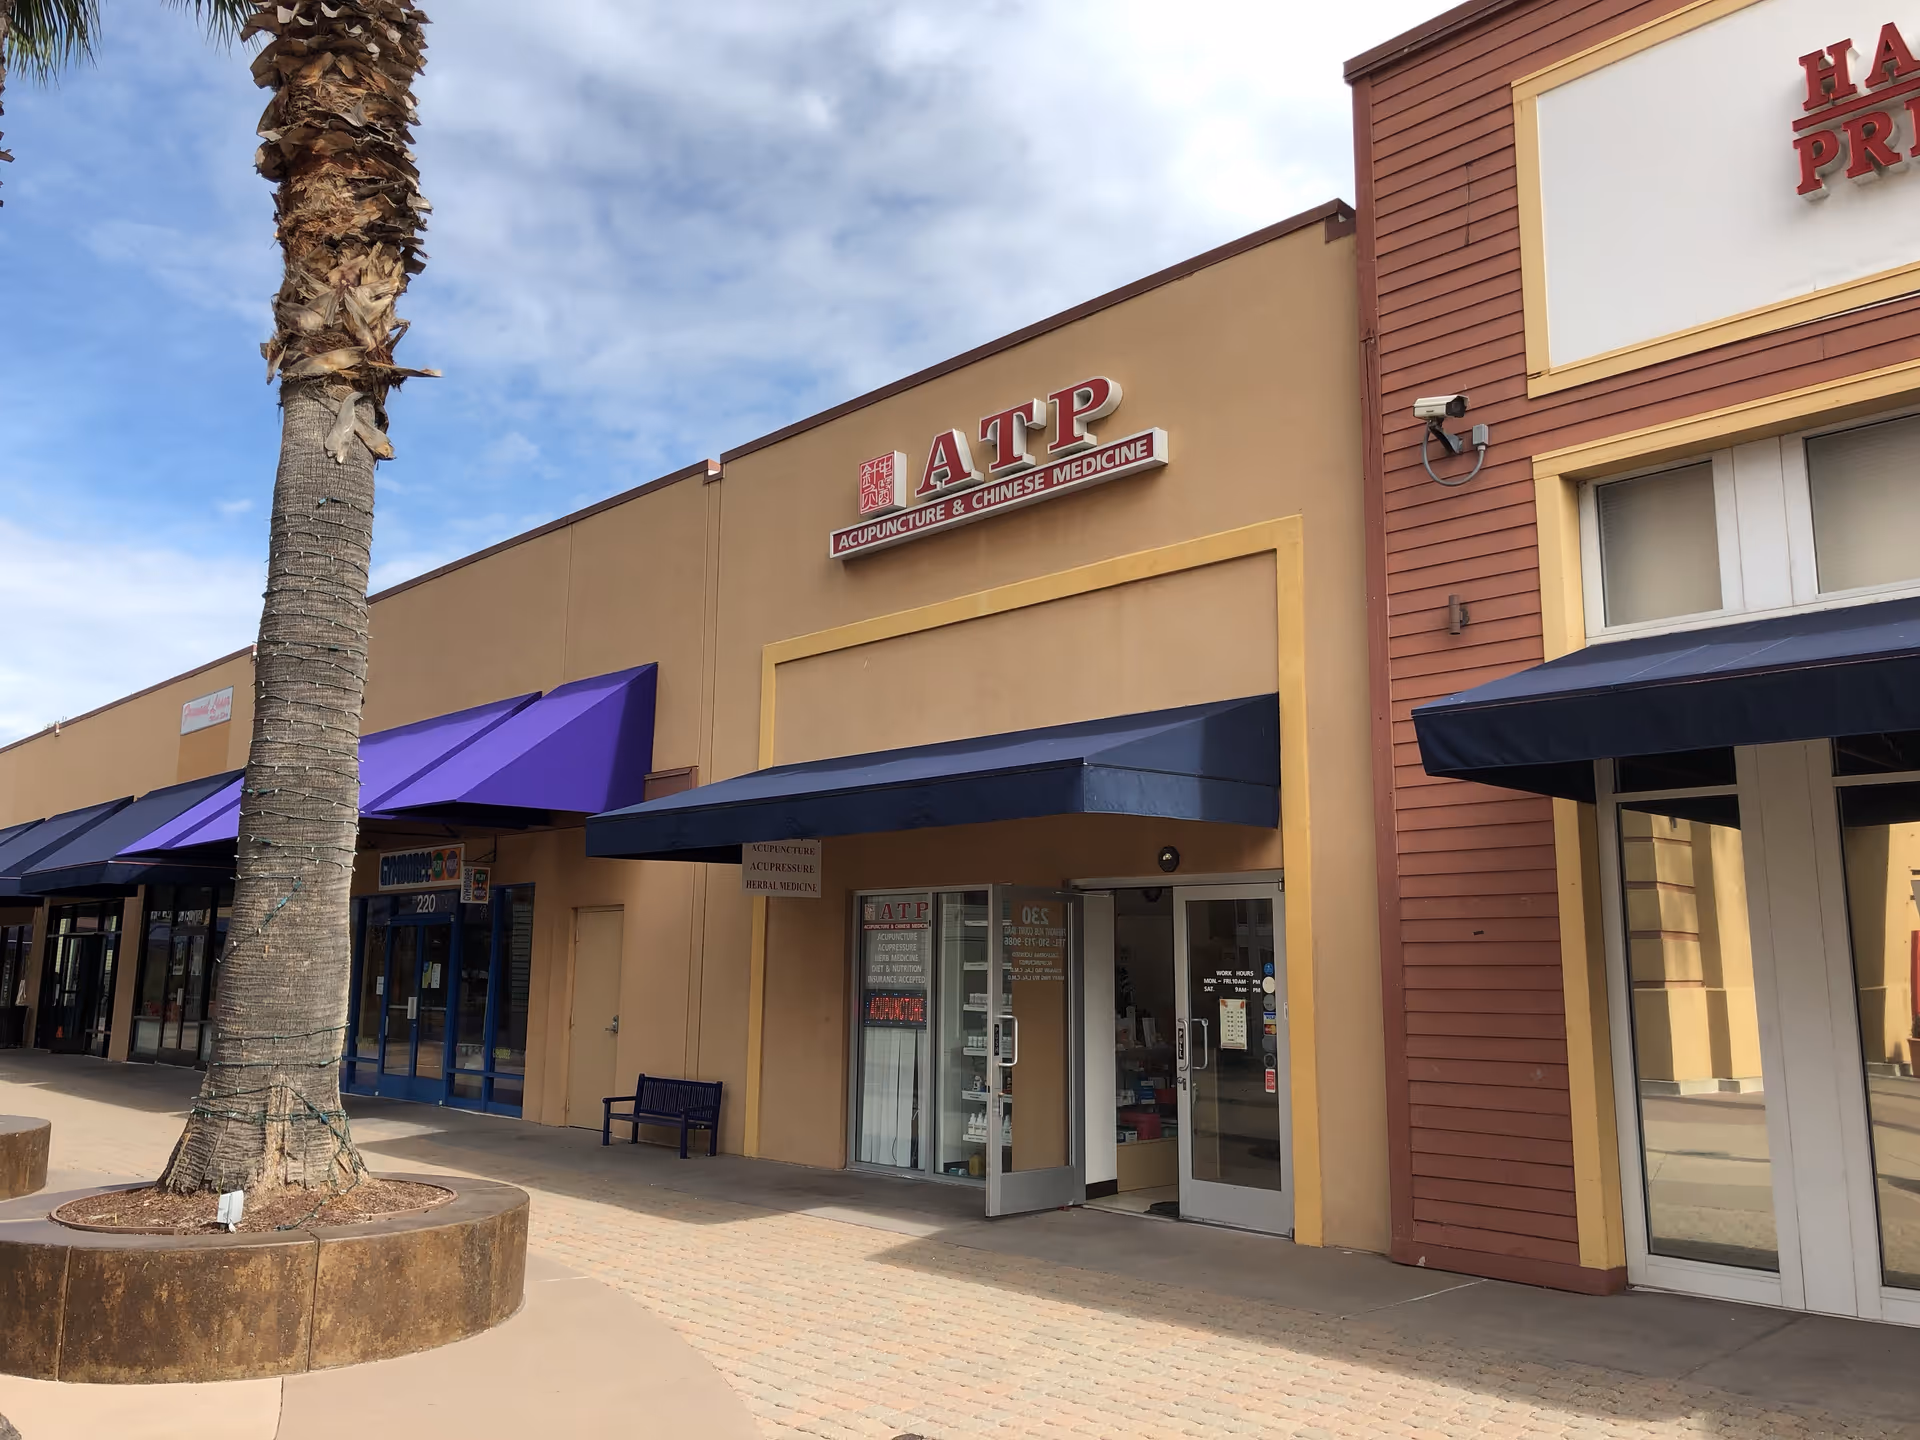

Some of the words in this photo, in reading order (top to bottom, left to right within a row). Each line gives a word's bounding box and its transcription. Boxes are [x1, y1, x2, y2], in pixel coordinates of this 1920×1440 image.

[915, 376, 1122, 498] ATP
[838, 505, 945, 550] ACUPUNCTURE
[952, 499, 965, 516] &
[972, 472, 1045, 509] CHINESE
[1052, 439, 1148, 485] MEDICINE
[752, 843, 815, 855] ACUPUNCTURE
[750, 862, 815, 874] ACUPRESSURE
[746, 879, 778, 890] HERBAL
[780, 881, 818, 892] MEDICINE
[416, 894, 436, 913] 220
[880, 901, 929, 920] ATP
[877, 932, 918, 941] ACUPUNCTURE
[877, 943, 917, 952] ACUPRESSURE
[875, 954, 890, 962] HERB
[891, 954, 919, 962] MEDICINE
[892, 964, 922, 973] NUTRITION
[867, 976, 897, 984] INSURANCE
[869, 997, 924, 1021] ACUPUNCTURE
